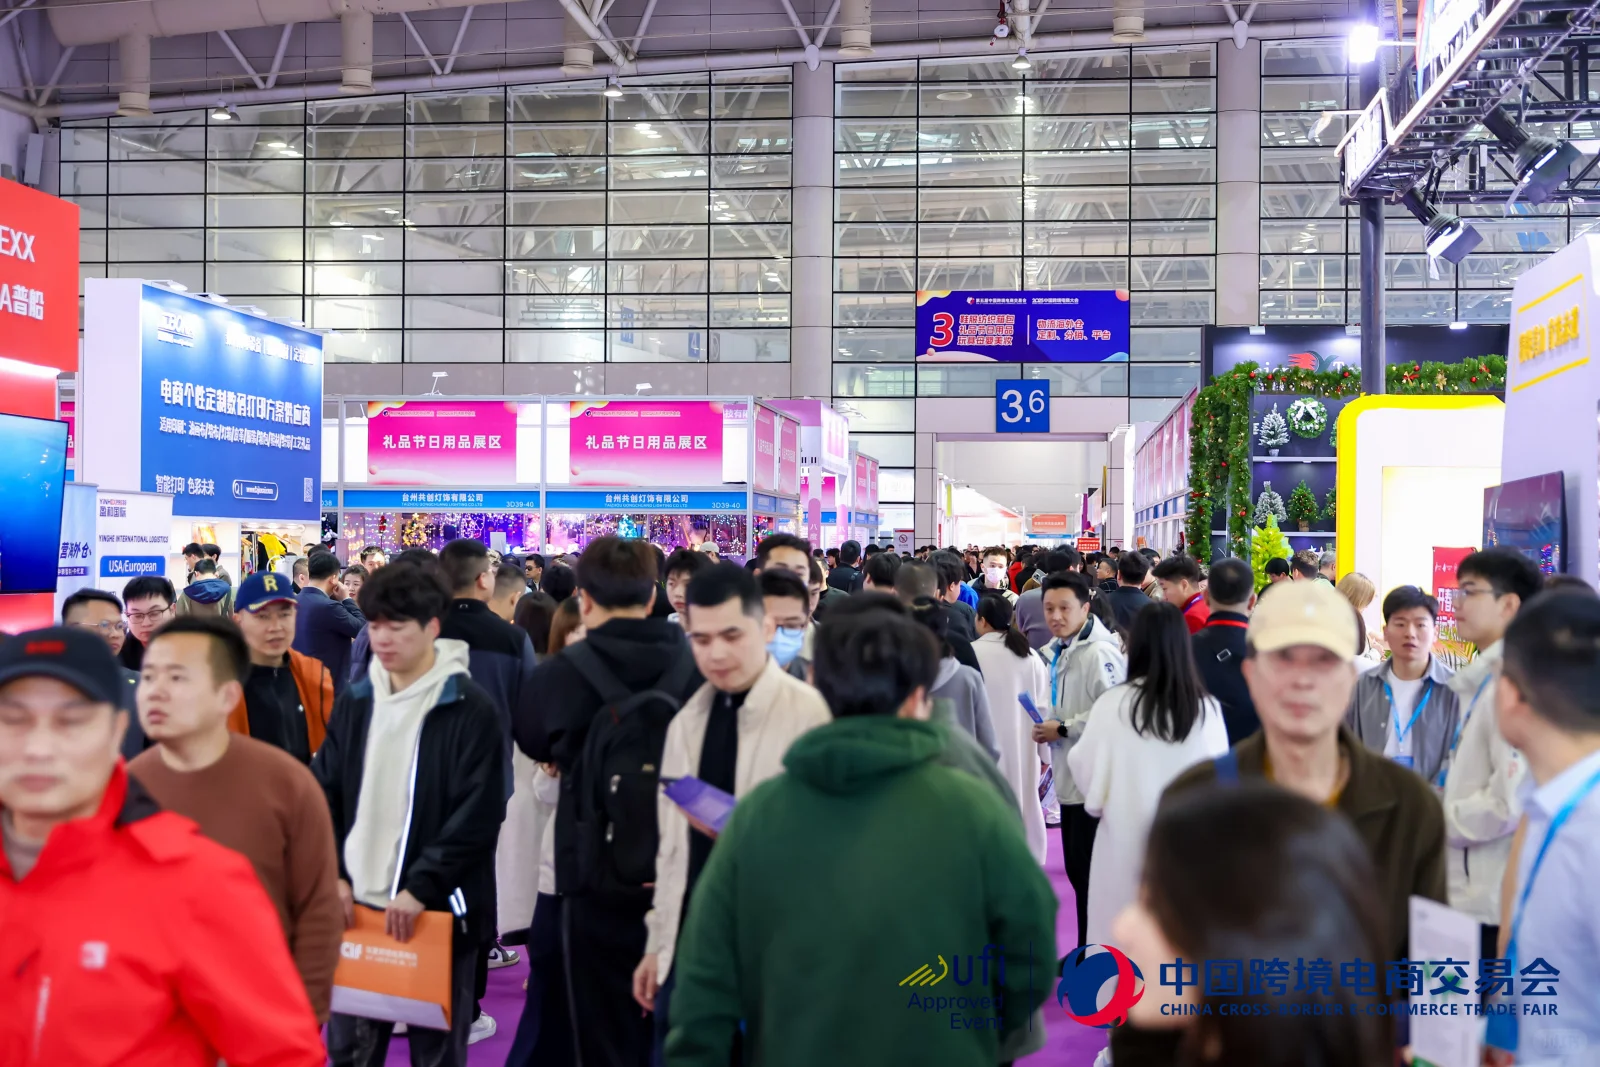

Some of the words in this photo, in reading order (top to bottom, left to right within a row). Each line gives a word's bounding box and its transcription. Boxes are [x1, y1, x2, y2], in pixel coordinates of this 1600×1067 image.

[930, 312, 954, 347] 3
[958, 325, 1014, 335] 礼品节日用品
[1037, 319, 1084, 330] 物流海外仓
[957, 336, 1013, 346] 玩具母婴美妆
[160, 378, 311, 427] 电商个性定制数码打印方案供应商
[1001, 389, 1045, 423] 3.6
[382, 435, 502, 449] 礼品节日用品展区
[585, 435, 707, 449] 礼品节日用品展区
[156, 474, 185, 495] 智能打印
[187, 477, 215, 496] 色彩未来
[402, 493, 484, 502] 台州共创灯饰有限公司
[605, 494, 689, 503] 台州共创灯饰有限公司
[108, 559, 157, 574] USA/European
